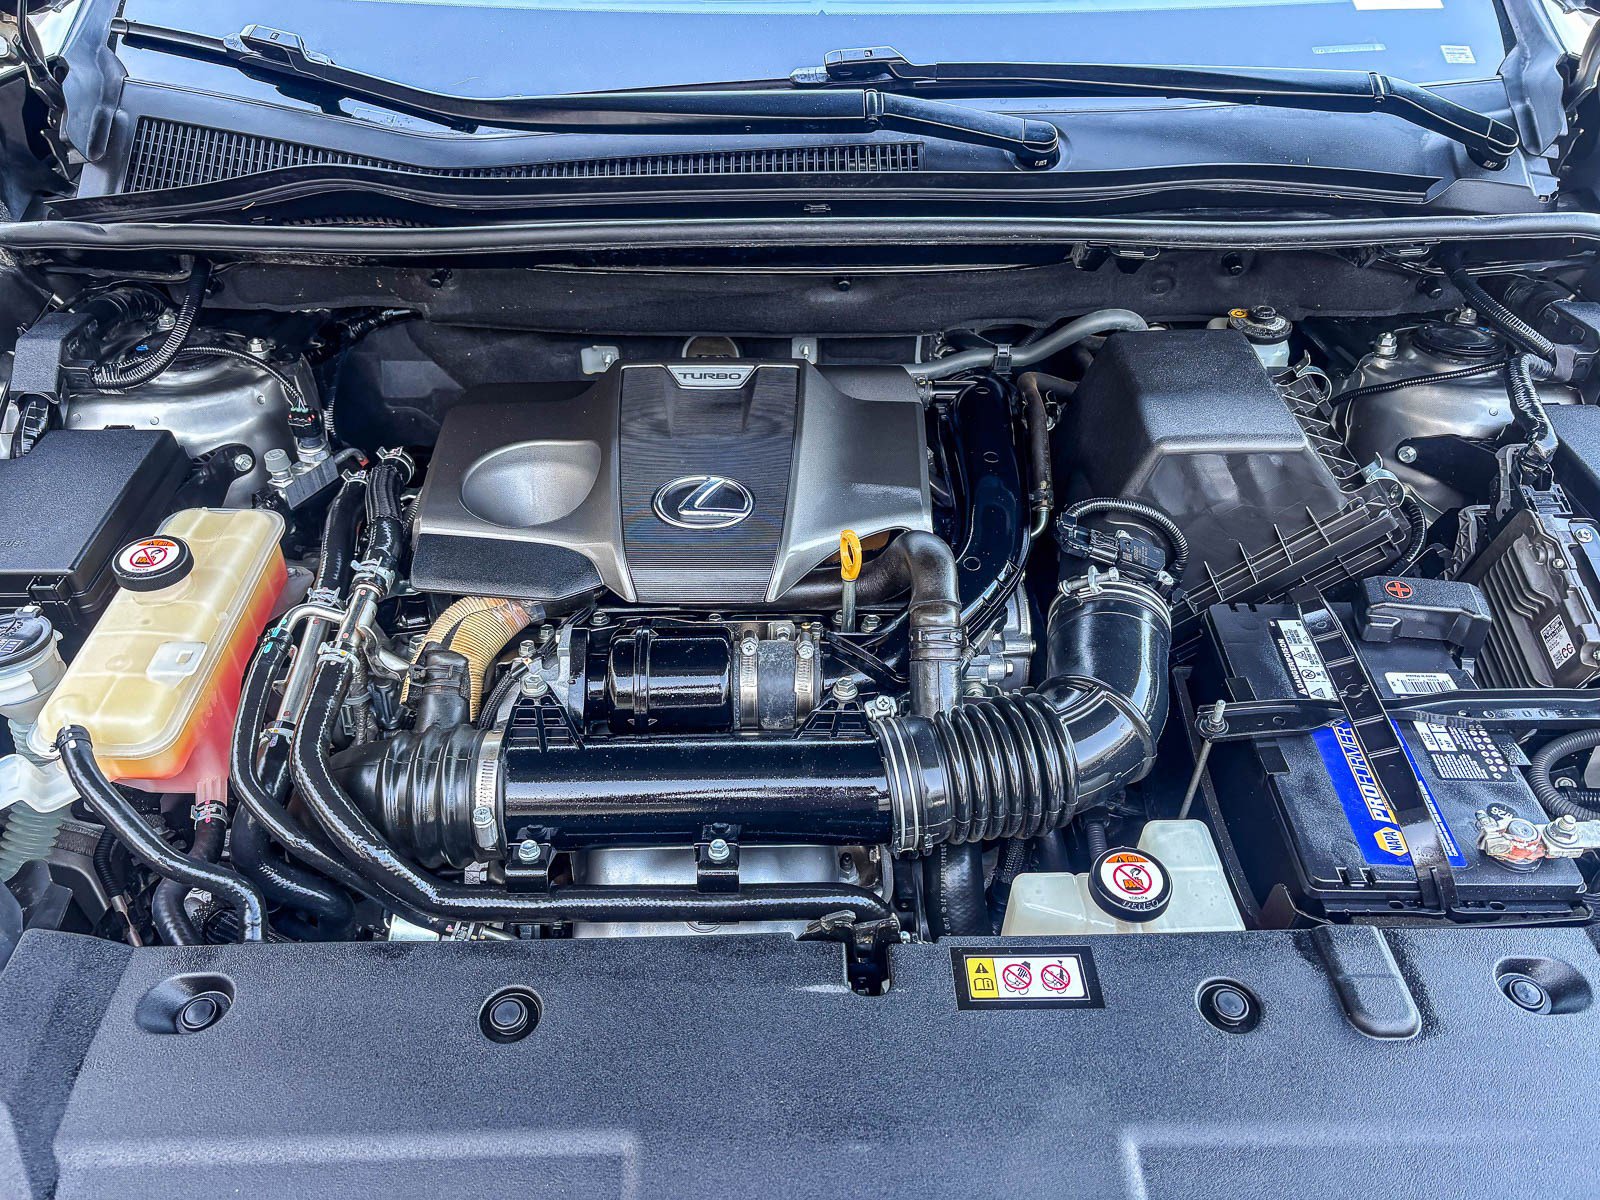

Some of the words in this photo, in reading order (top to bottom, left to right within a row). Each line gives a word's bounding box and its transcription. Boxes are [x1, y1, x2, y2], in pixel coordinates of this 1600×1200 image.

[678, 372, 742, 380] TURBO
[1336, 726, 1393, 823] PROFORMER
[1382, 831, 1404, 851] NAPA
[1122, 899, 1159, 910] DENSO
